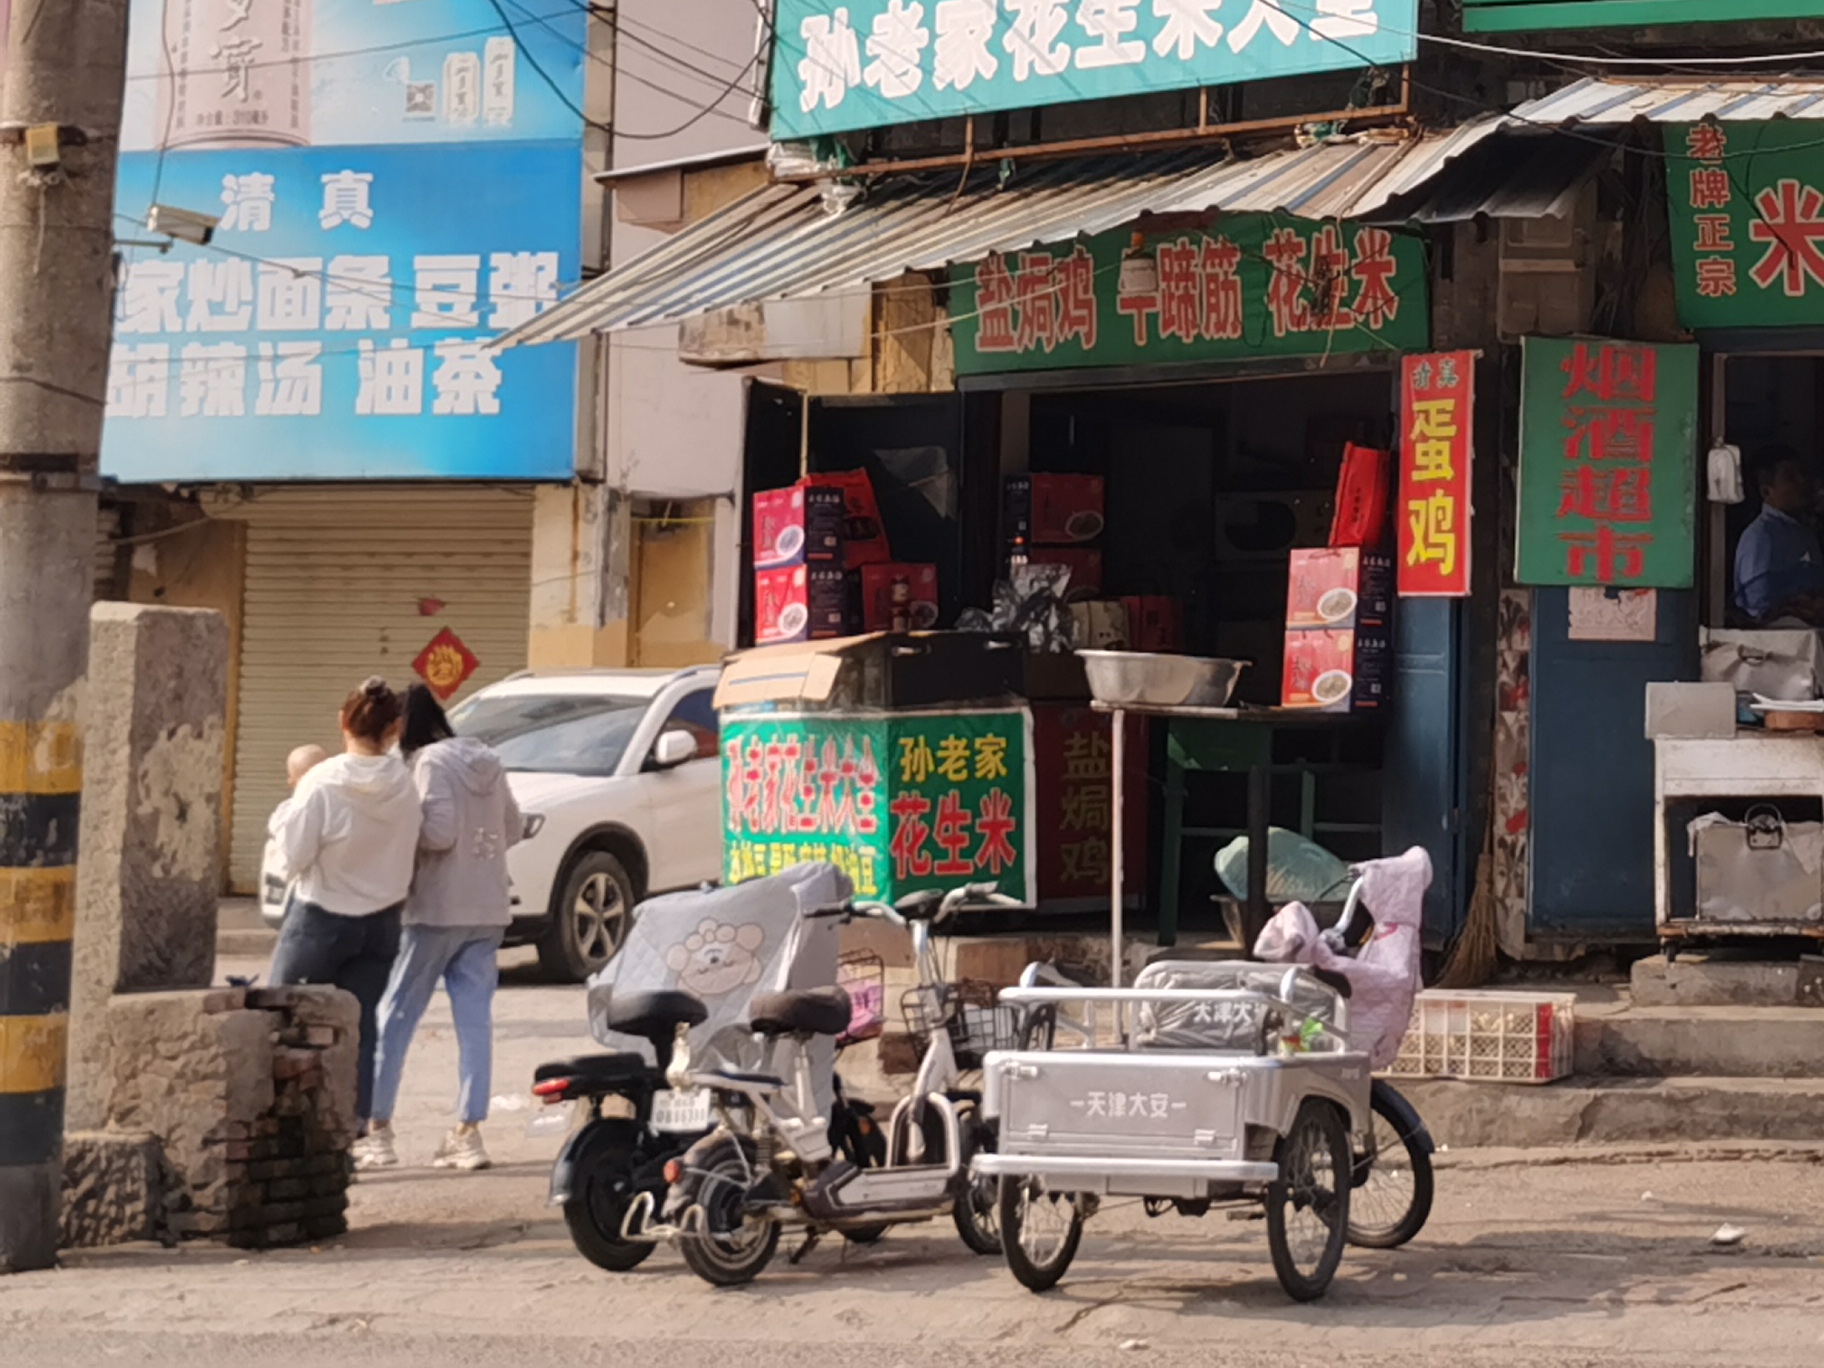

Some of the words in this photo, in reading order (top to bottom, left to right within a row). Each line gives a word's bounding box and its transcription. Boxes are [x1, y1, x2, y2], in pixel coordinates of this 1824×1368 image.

[219, 171, 375, 232] 清真
[1685, 124, 1738, 298] 老牌正宗
[975, 246, 1098, 353] 盐焗鸡
[355, 337, 503, 416] 油茶
[1407, 398, 1458, 576] 蛋鸡
[1557, 343, 1658, 583] 烟酒超市
[899, 735, 1008, 783] 孙老家
[890, 787, 1017, 880] 花生米
